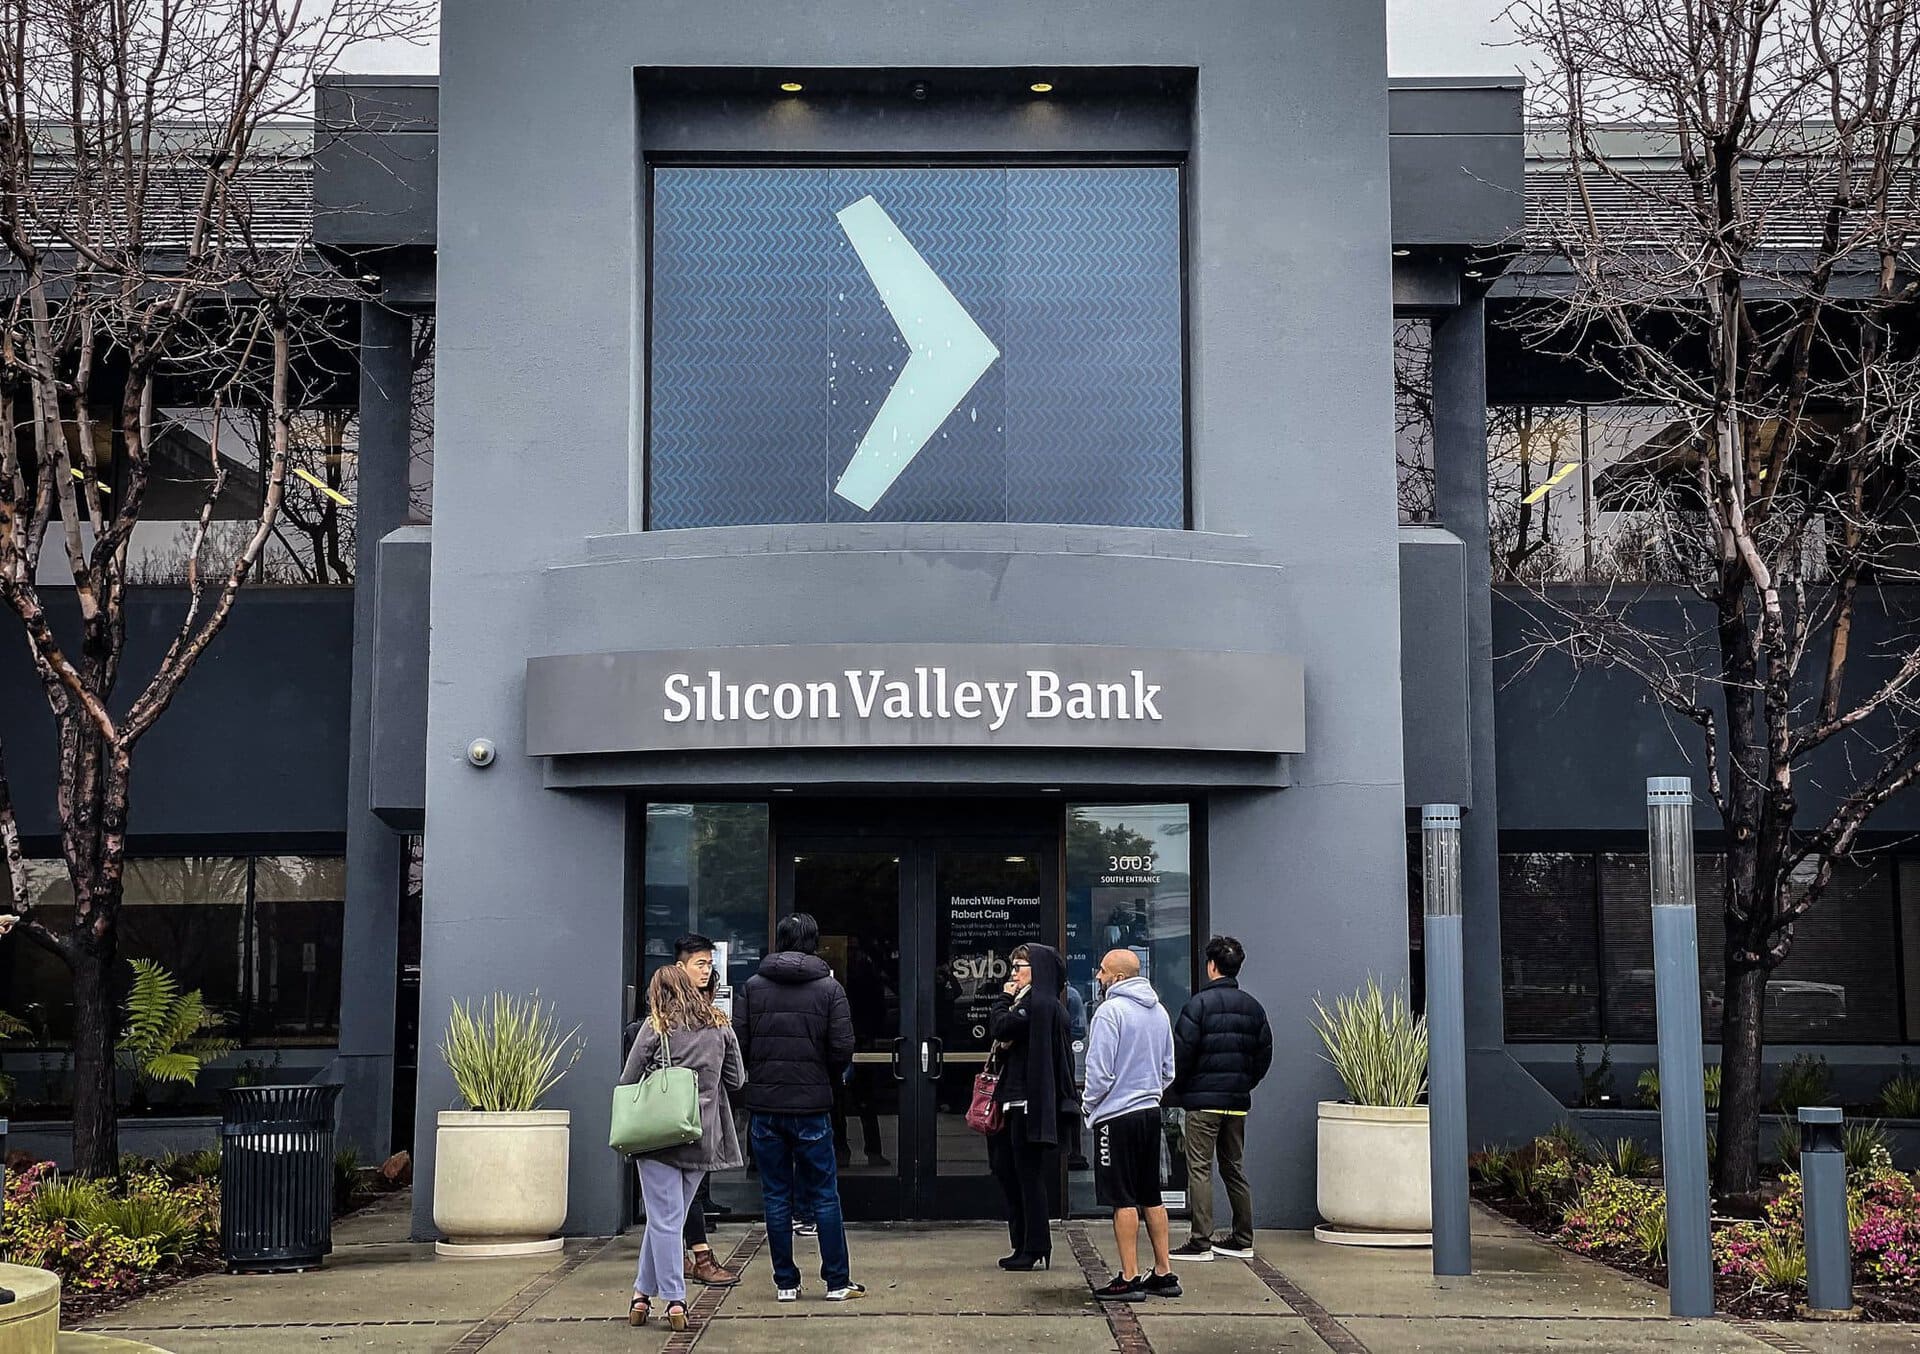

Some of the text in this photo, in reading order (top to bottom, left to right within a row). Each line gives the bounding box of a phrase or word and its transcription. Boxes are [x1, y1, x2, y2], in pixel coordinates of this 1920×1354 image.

[662, 667, 1163, 731] Silicon Valley Bank
[1108, 855, 1153, 872] 3003
[1100, 875, 1161, 884] SOUTH ENTRANCE
[951, 896, 981, 906] March
[981, 896, 1006, 906] Wine
[951, 910, 1010, 920] Robert Craig
[952, 949, 1007, 979] svb
